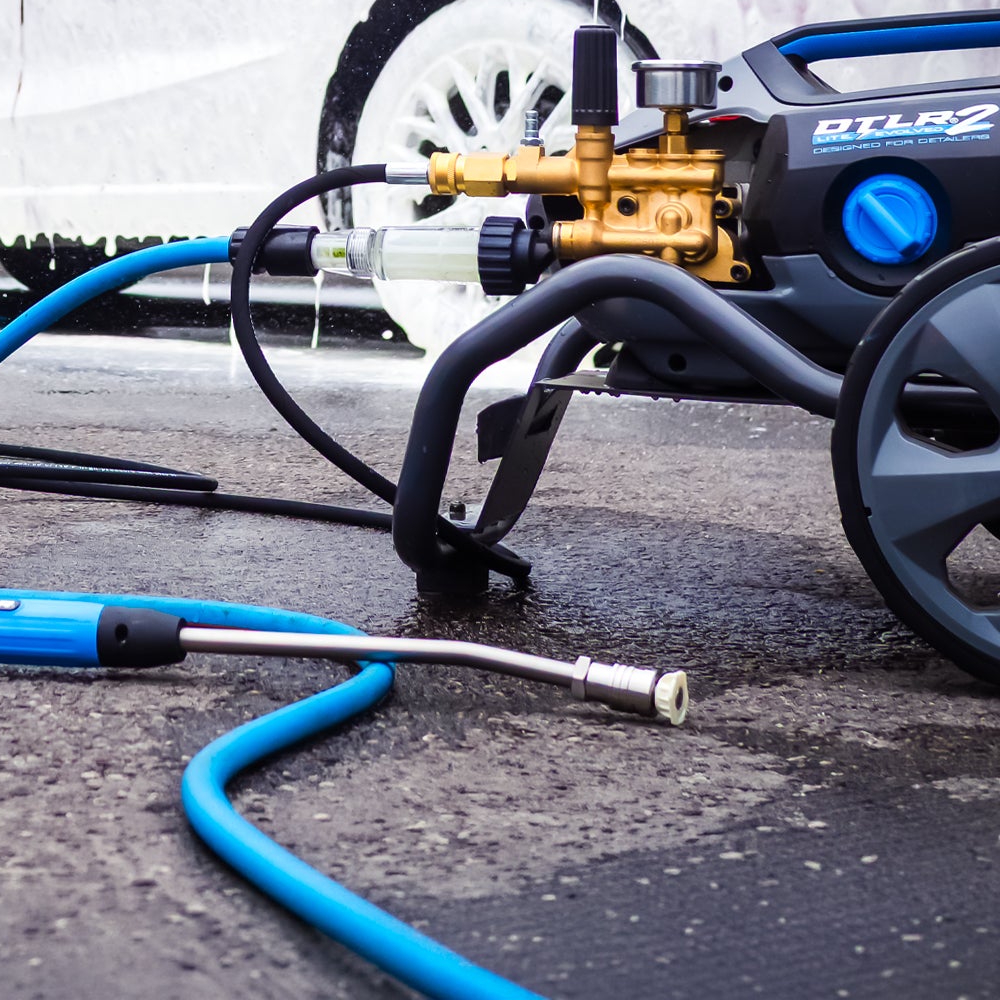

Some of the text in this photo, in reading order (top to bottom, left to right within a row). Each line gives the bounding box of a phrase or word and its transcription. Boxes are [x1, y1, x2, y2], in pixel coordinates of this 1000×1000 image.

[816, 126, 945, 143] LITE EVOLVED
[813, 134, 990, 155] DESIGNED FOR DETAILERS
